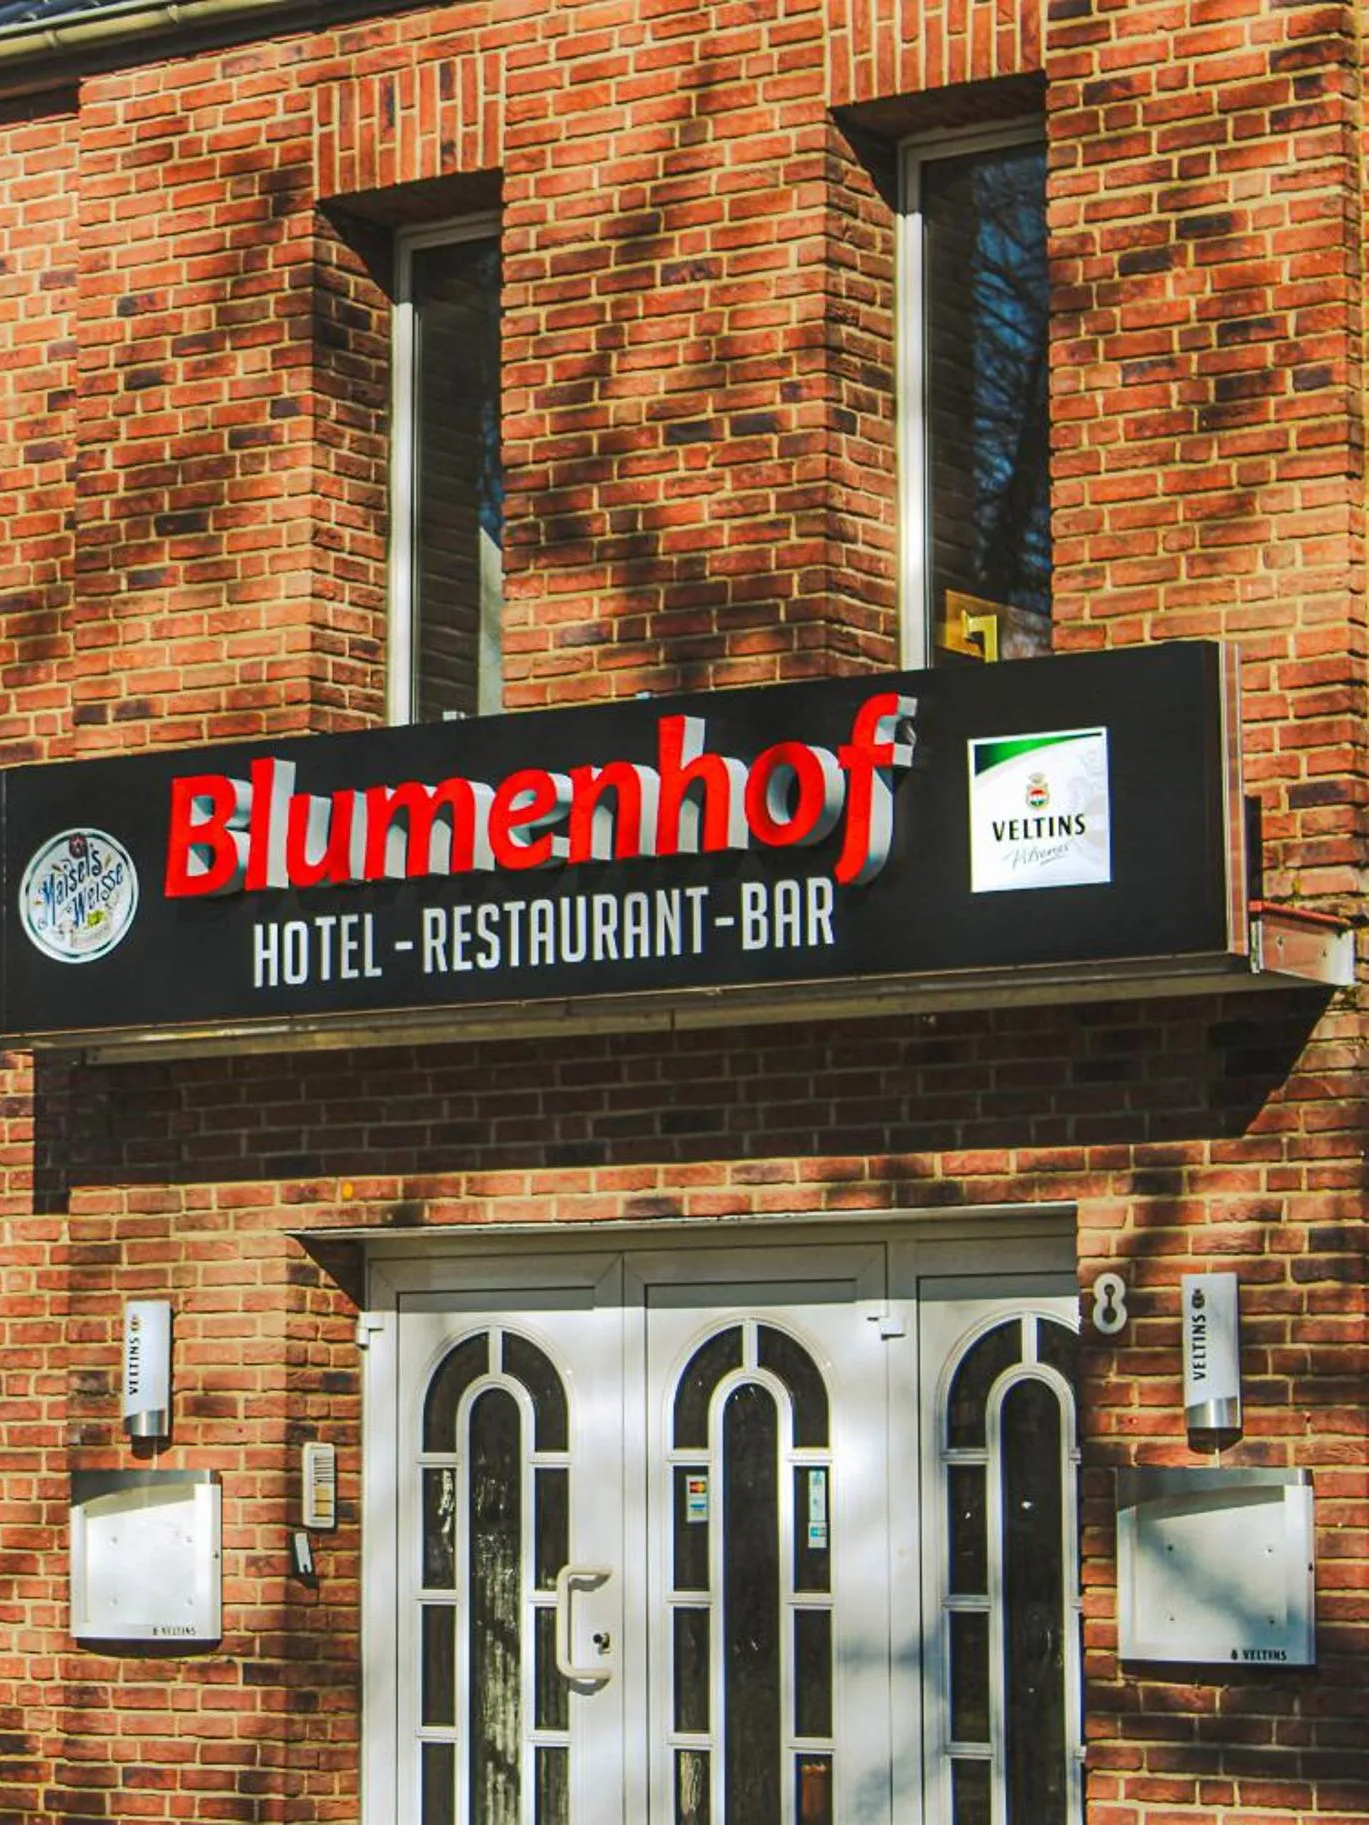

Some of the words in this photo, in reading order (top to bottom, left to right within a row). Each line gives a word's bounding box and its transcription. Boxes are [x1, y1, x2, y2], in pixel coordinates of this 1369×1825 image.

[164, 692, 917, 898] Blumenhof
[992, 813, 1086, 842] VELTINS
[1093, 1272, 1128, 1335] 8
[129, 1337, 140, 1395] VELTINS
[1192, 1314, 1207, 1381] VELTINS
[1242, 1648, 1288, 1661] VELTINS
